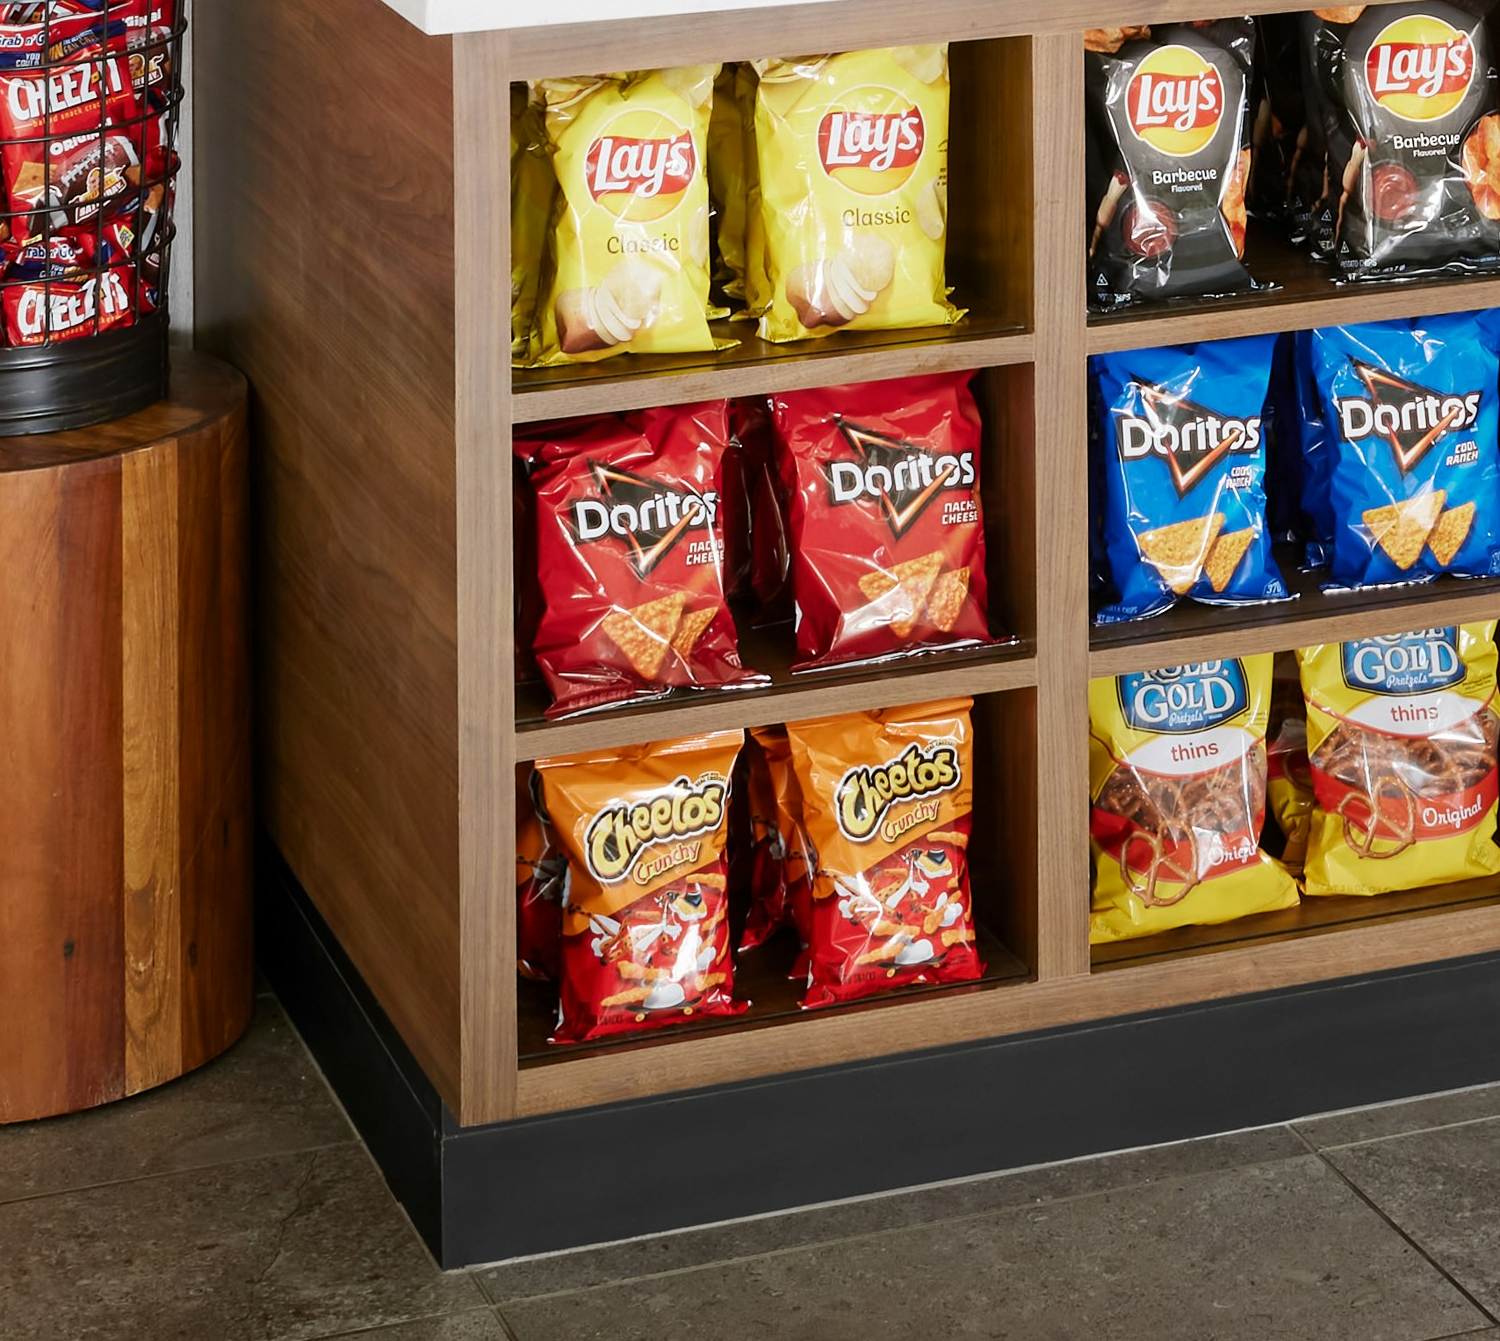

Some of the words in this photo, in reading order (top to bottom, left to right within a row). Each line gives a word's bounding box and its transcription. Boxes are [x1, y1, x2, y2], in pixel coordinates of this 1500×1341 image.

[1374, 37, 1468, 98] Lay's
[1136, 70, 1218, 131] Lay's
[826, 108, 921, 173] Lay's
[1393, 132, 1461, 150] Barbecue
[1412, 147, 1447, 158] Flavored
[593, 133, 693, 199] Lay's
[1152, 167, 1218, 186] Barbecue
[1170, 183, 1203, 193] Flavored
[842, 205, 911, 228] Classic
[606, 233, 680, 255] Classic
[1340, 392, 1480, 440] Doritos
[1121, 416, 1262, 458] Doritos
[1454, 441, 1478, 454] COOL
[830, 451, 976, 502] Doritos
[1445, 451, 1479, 466] RANCH
[575, 489, 718, 542] Doritos
[941, 510, 978, 525] CHEESE
[1352, 638, 1459, 684] GOLD
[1386, 672, 1428, 688] Pretzels
[1134, 674, 1236, 724] GOLD
[1390, 704, 1439, 722] thins
[1168, 711, 1204, 726] Pretzels
[1170, 741, 1219, 762] thins
[839, 743, 957, 839] Cheetos
[589, 775, 727, 880] Cheetos
[881, 799, 942, 843] Crunchy
[1422, 797, 1483, 829] Original
[633, 841, 701, 885] Crunchy
